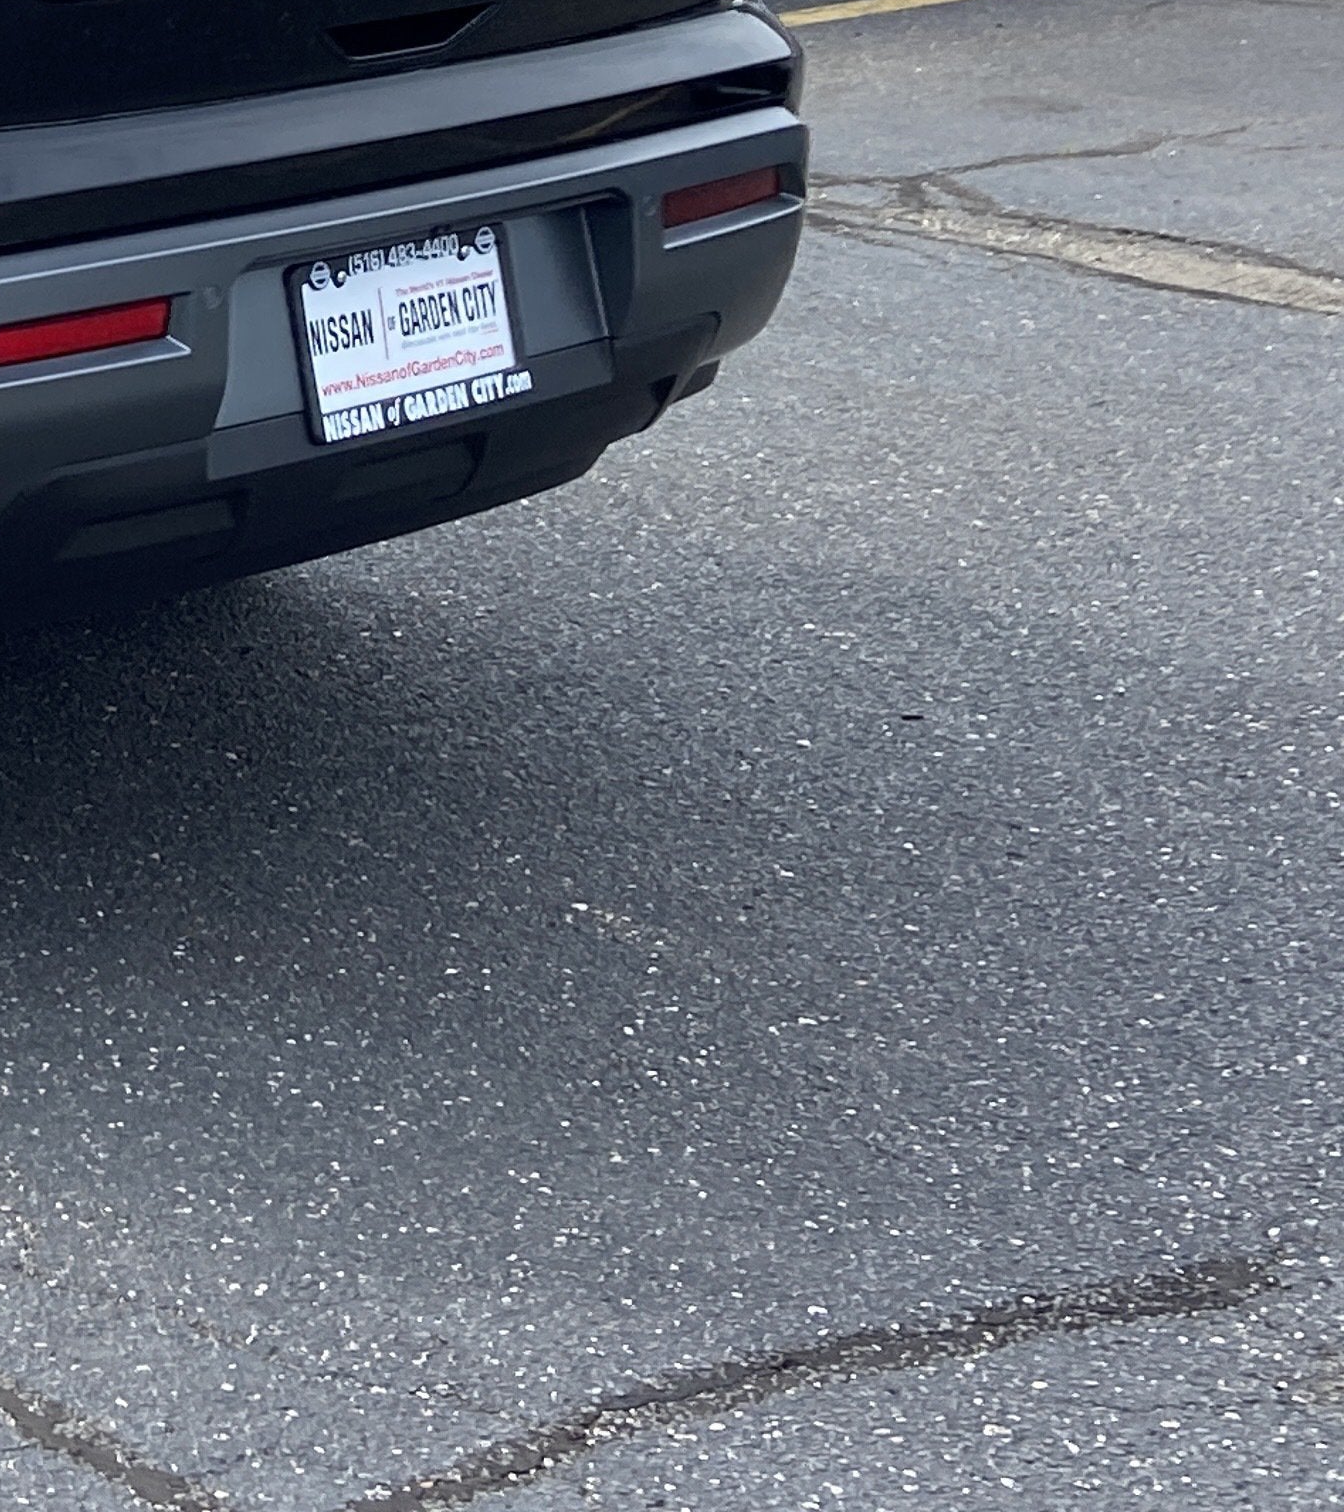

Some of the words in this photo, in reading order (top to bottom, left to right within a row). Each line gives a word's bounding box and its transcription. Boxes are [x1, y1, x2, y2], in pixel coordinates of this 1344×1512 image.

[309, 308, 375, 357] NISSAN
[398, 289, 462, 336] GARDEN
[462, 280, 497, 321] CITY
[321, 343, 505, 397] www.NissanofGardenCity.com
[322, 402, 386, 443] NISSAN
[386, 398, 401, 426] of
[403, 382, 470, 422] GARDEN
